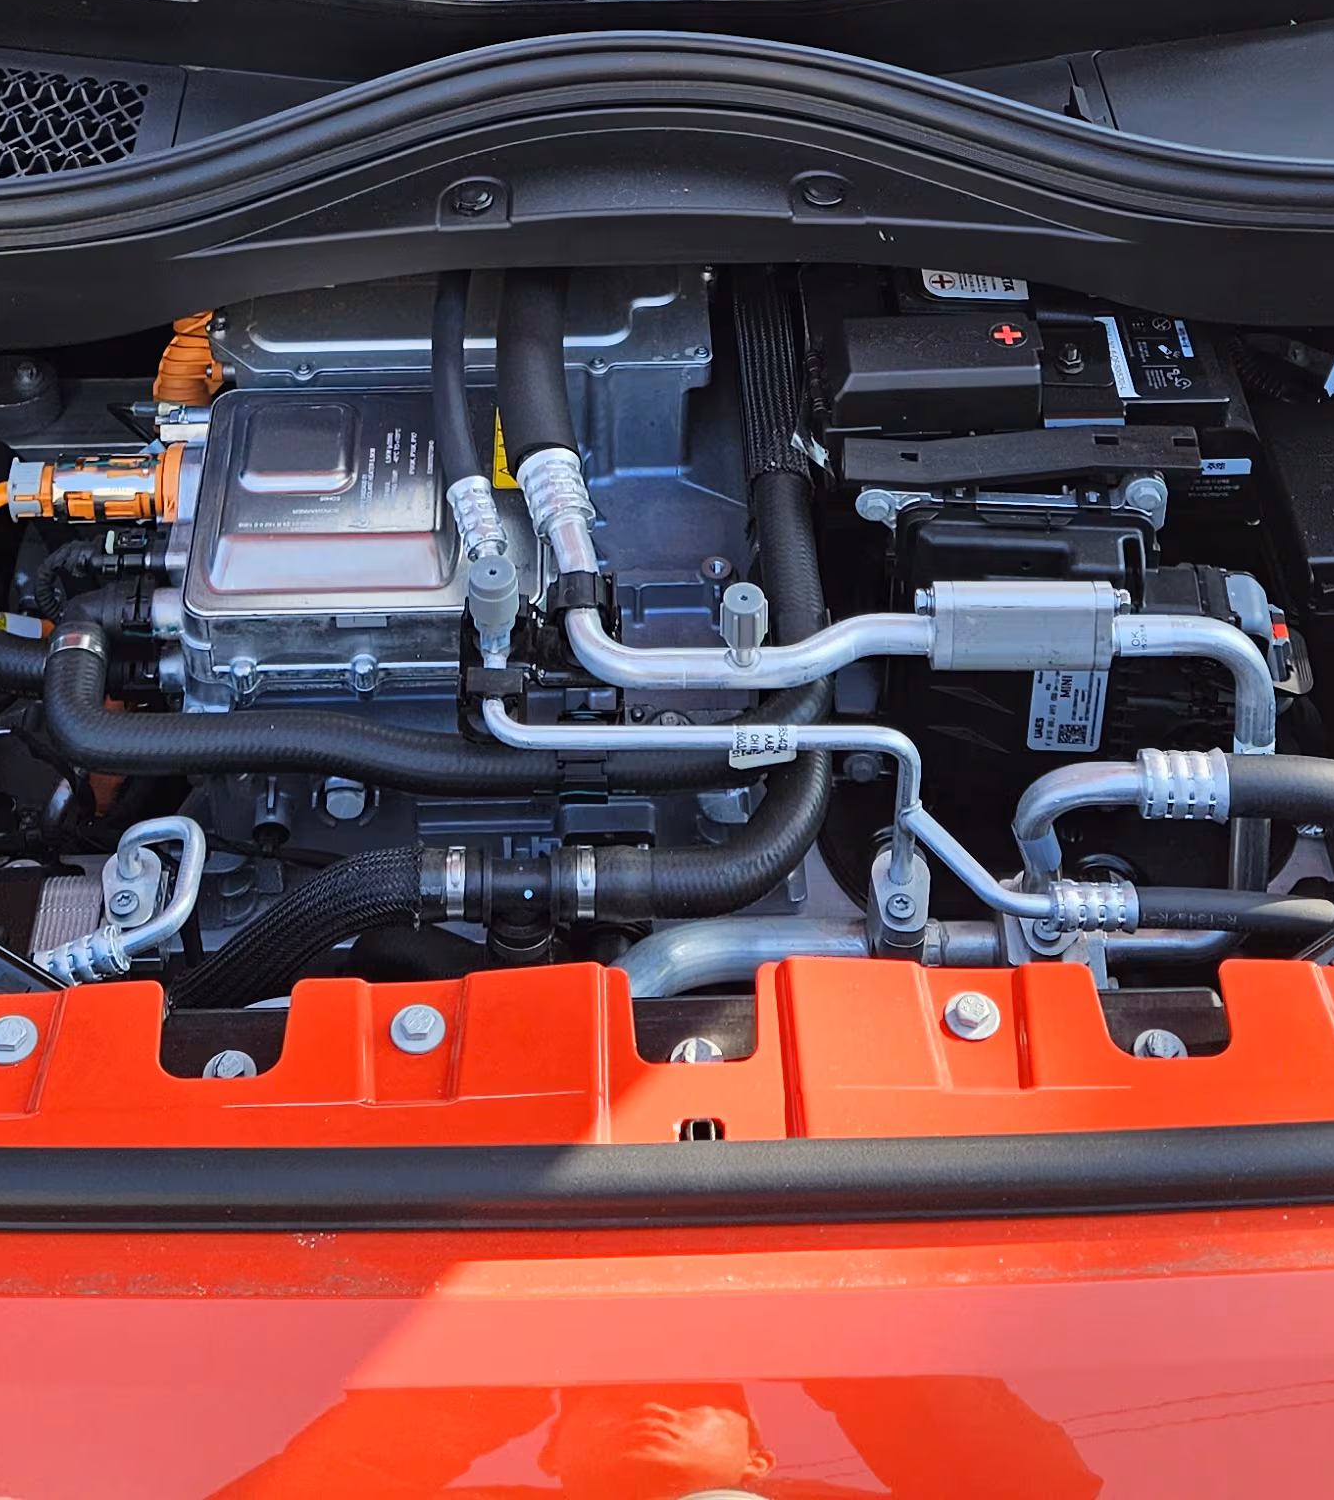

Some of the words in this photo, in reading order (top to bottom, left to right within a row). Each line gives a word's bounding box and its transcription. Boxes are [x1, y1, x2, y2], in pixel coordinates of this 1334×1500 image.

[1131, 631, 1141, 647] OK
[1060, 675, 1073, 698] MINI
[1034, 717, 1045, 739] UAES
